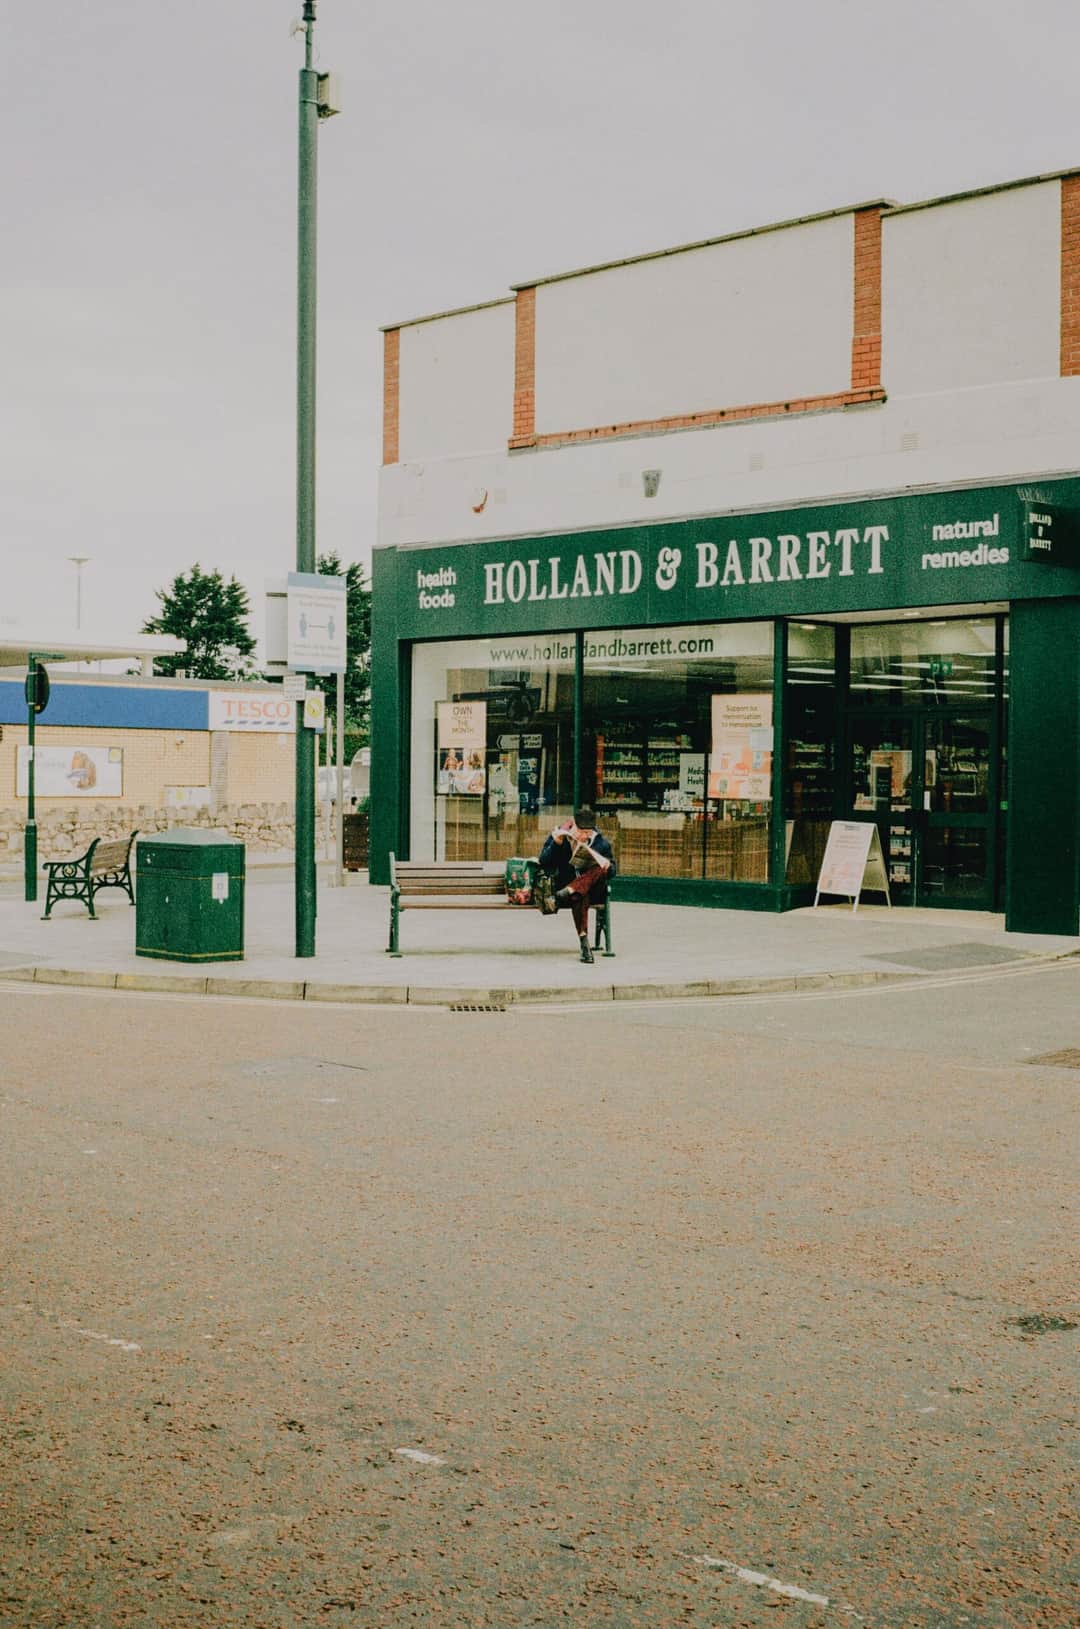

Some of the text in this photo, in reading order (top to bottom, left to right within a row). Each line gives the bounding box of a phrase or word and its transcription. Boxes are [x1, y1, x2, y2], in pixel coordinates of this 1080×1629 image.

[932, 513, 999, 541] natural
[483, 525, 890, 605] HOLLAND & BARRETT
[921, 543, 1010, 570] remedies
[417, 567, 456, 589] health
[418, 590, 456, 609] foods
[221, 699, 291, 719] TESCO
